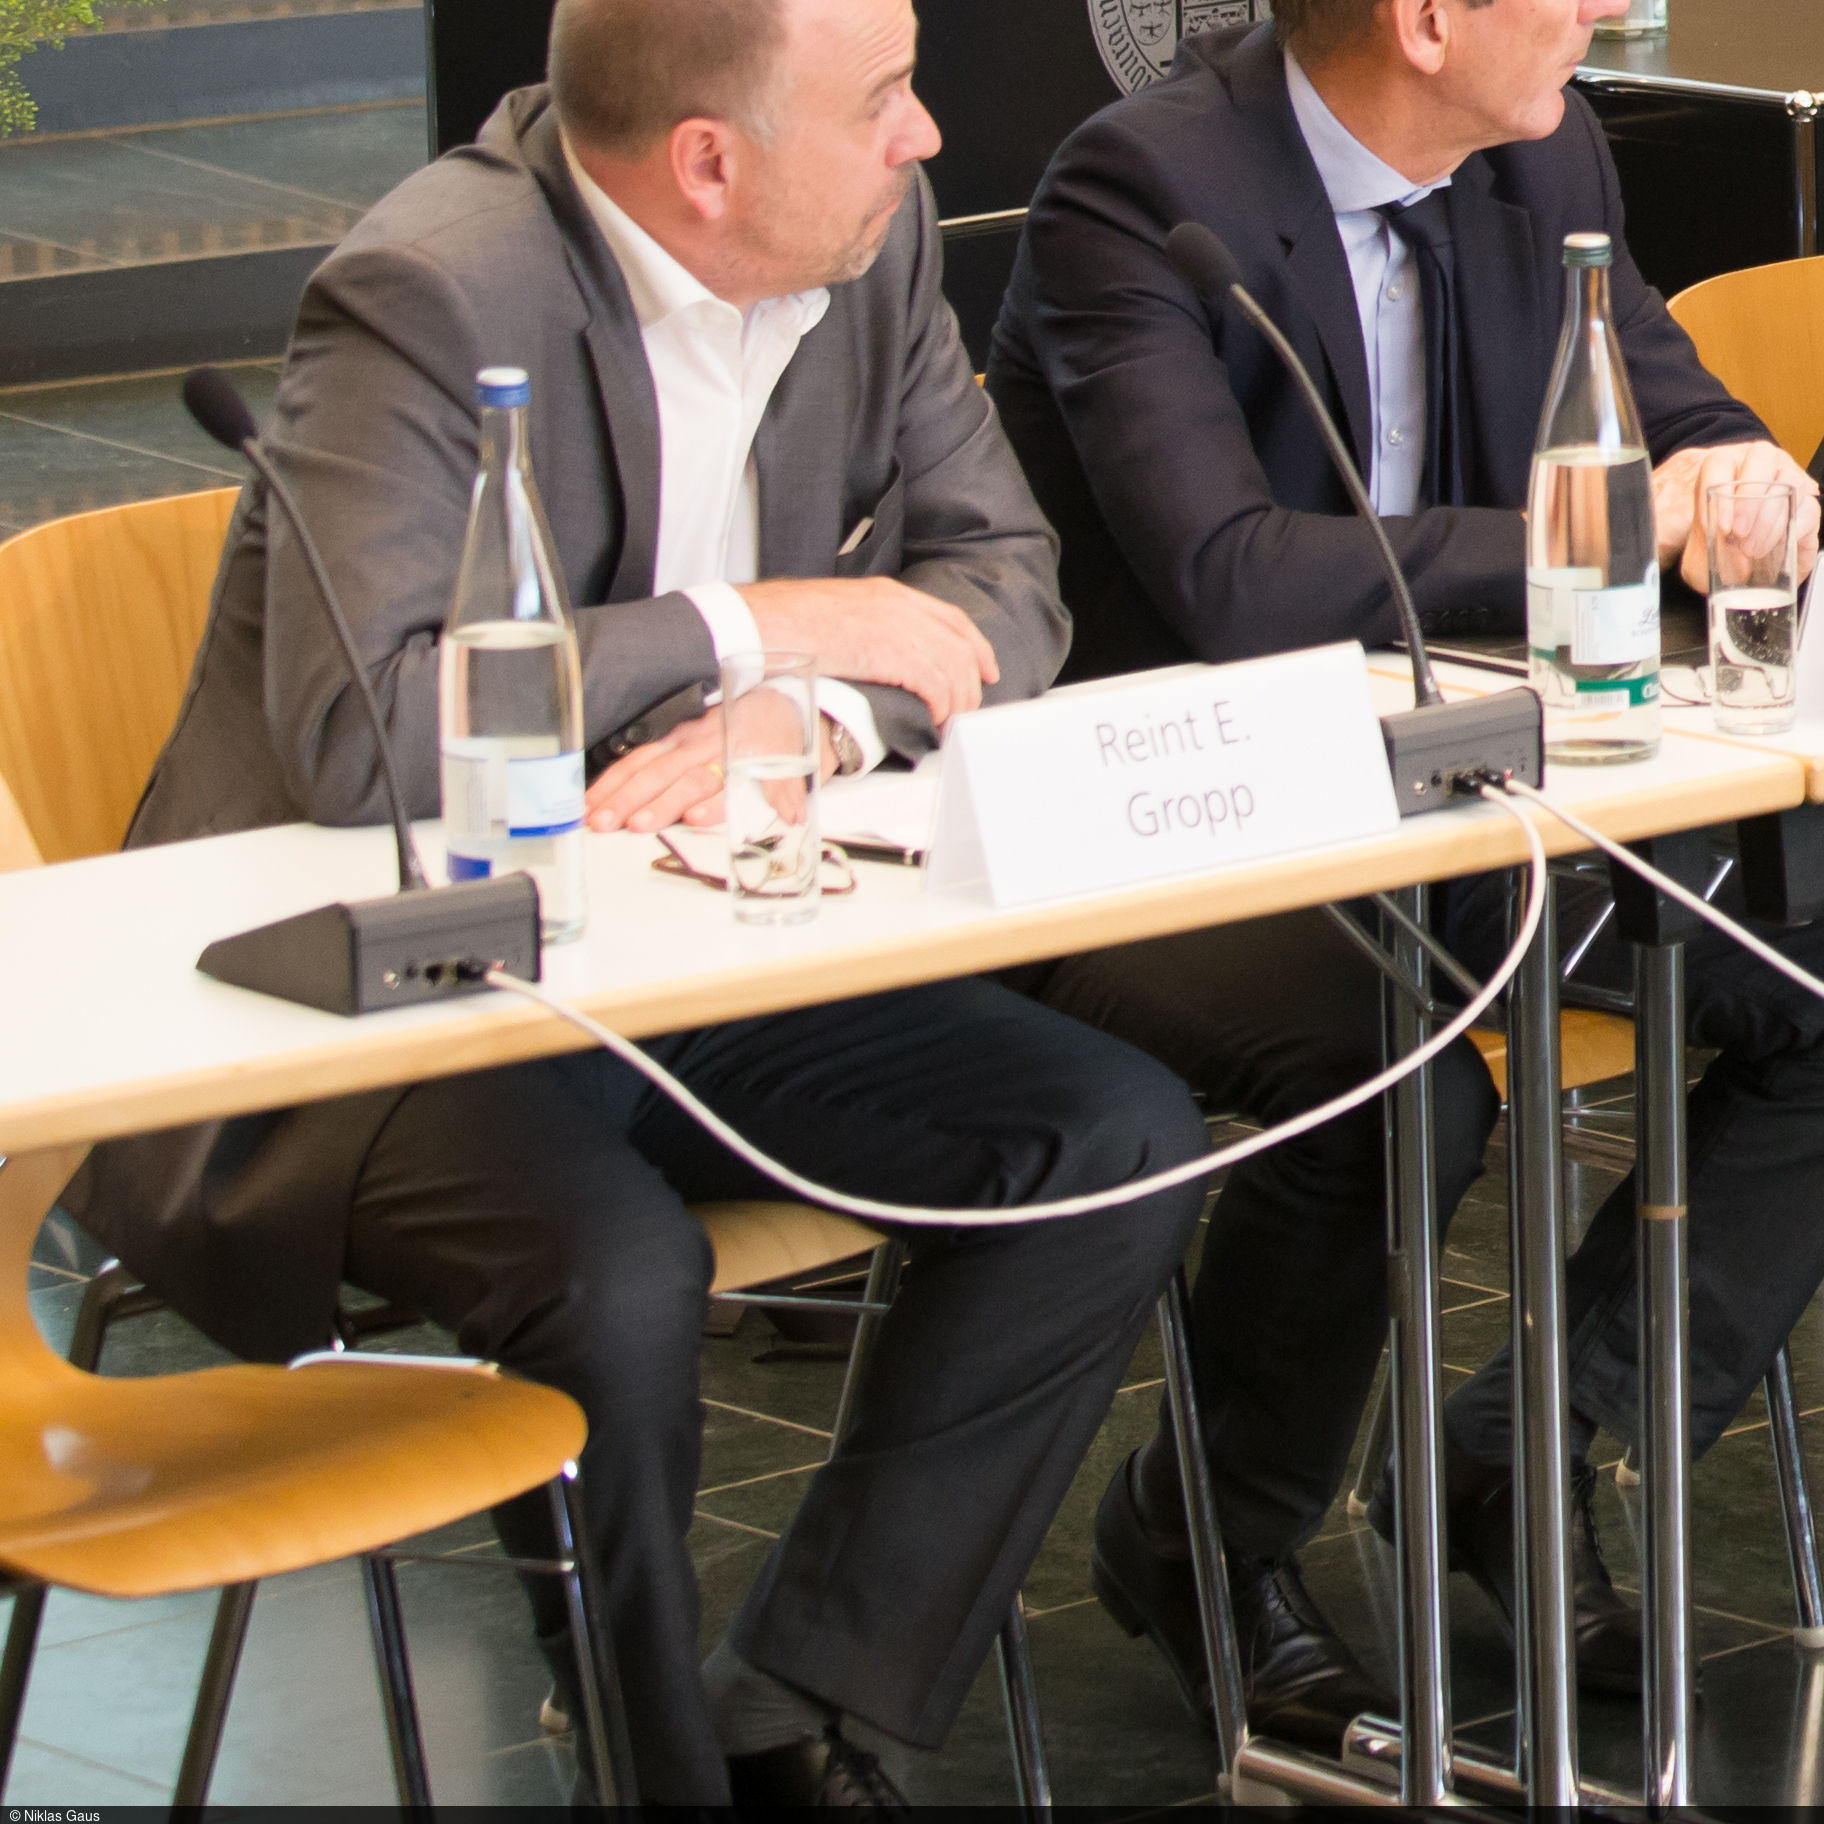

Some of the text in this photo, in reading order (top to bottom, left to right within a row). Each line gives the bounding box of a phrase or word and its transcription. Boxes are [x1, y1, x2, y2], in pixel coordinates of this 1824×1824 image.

[1095, 700, 1251, 766] Reint E.
[1127, 784, 1254, 837] Gropp
